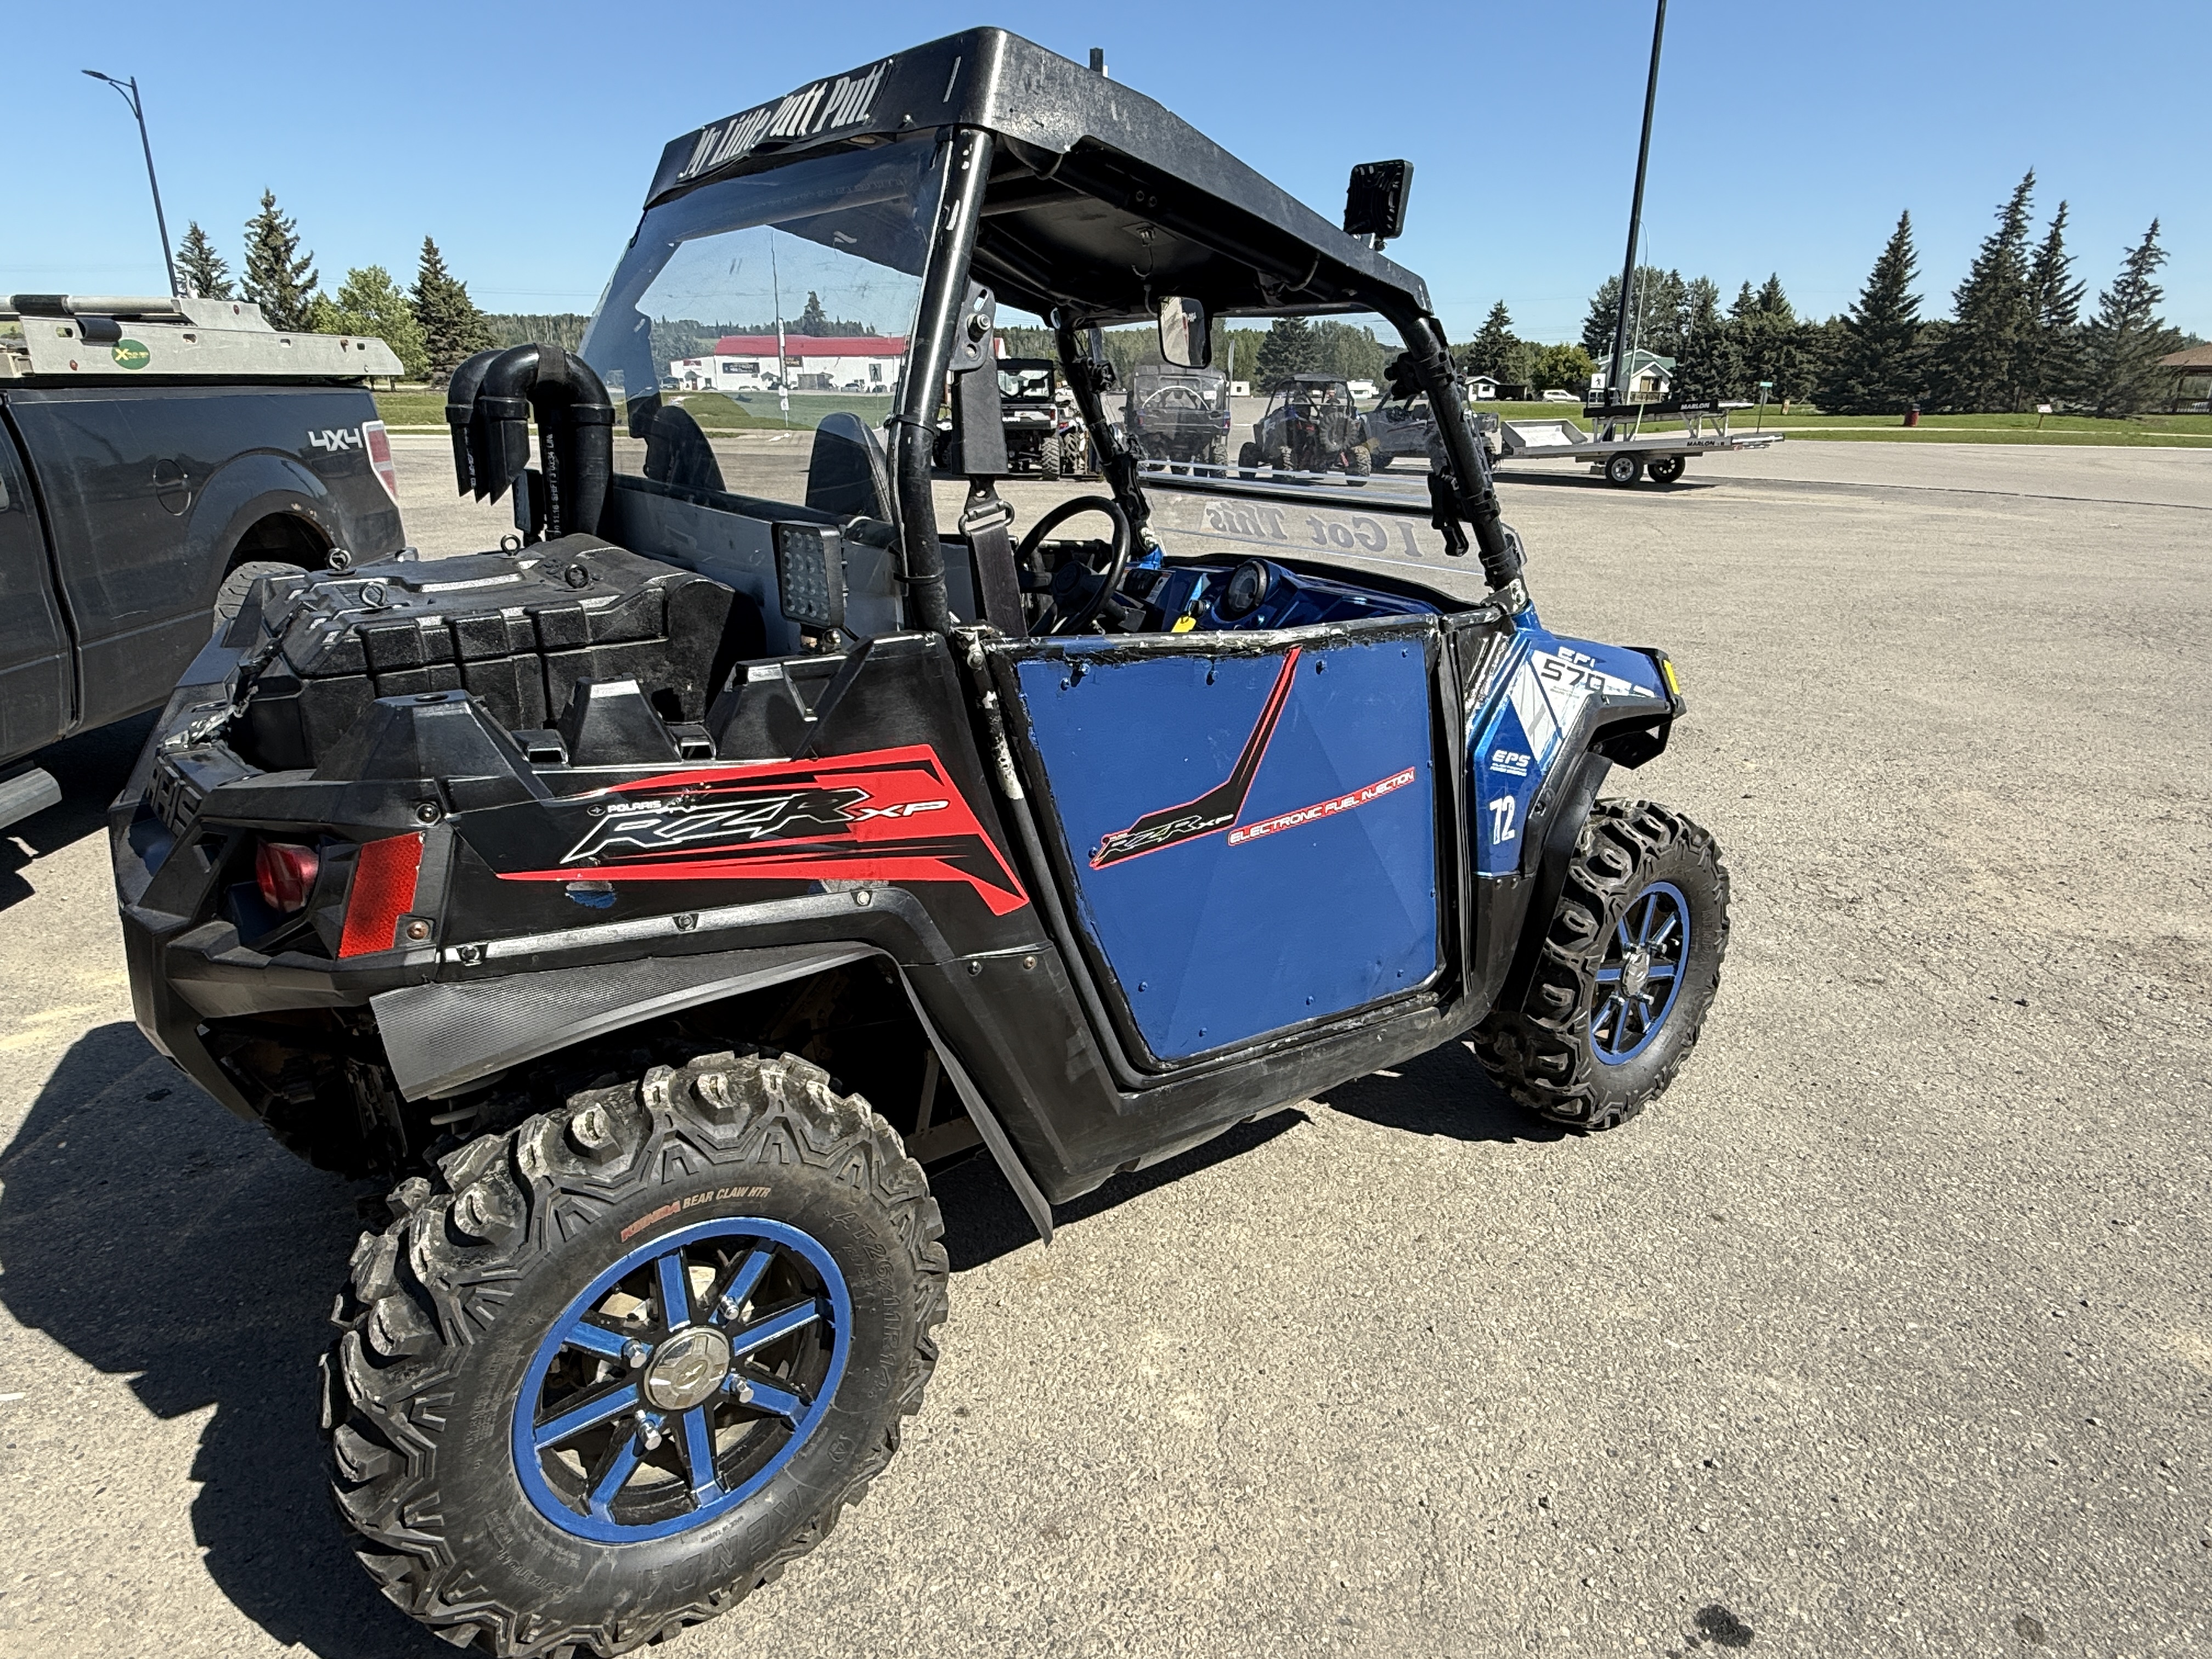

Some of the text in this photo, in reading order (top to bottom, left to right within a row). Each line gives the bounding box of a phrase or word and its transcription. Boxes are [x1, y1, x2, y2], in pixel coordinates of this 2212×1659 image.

[683, 61, 887, 178] My Little Putt Putt
[1680, 402, 1711, 410] MARLON
[307, 428, 364, 452] 4X4
[1558, 646, 1595, 668] EFI
[1541, 658, 1606, 692] 570
[1492, 749, 1531, 768] EPS
[607, 800, 662, 813] POLARIS
[1230, 770, 1414, 844] ELECTRONIC FUEL INJECTION
[560, 788, 950, 865] RZR XP
[1093, 814, 1234, 862] RZR XP
[682, 1190, 714, 1209] BEAR
[715, 1186, 750, 1200] CLAW
[747, 1186, 771, 1199] HTR
[636, 1485, 805, 1602] KENDA
